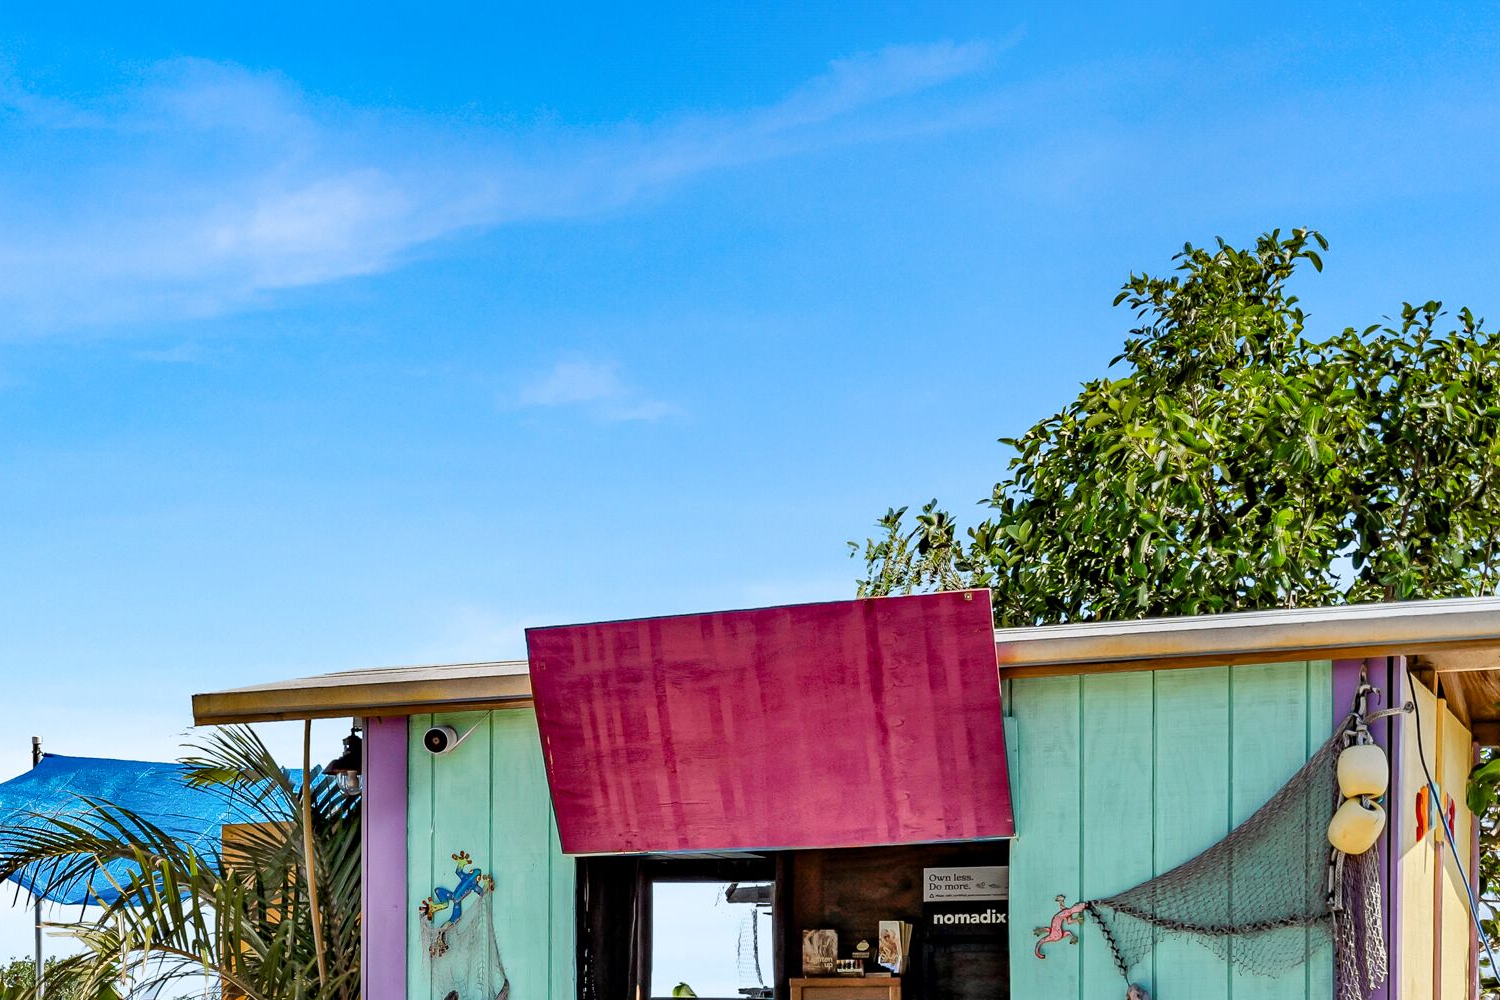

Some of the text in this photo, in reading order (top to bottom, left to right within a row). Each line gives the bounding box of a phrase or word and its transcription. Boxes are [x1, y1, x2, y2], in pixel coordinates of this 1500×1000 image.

[928, 873, 974, 882] Own less.
[929, 883, 971, 891] Do more.
[933, 909, 1006, 924] nomadix
